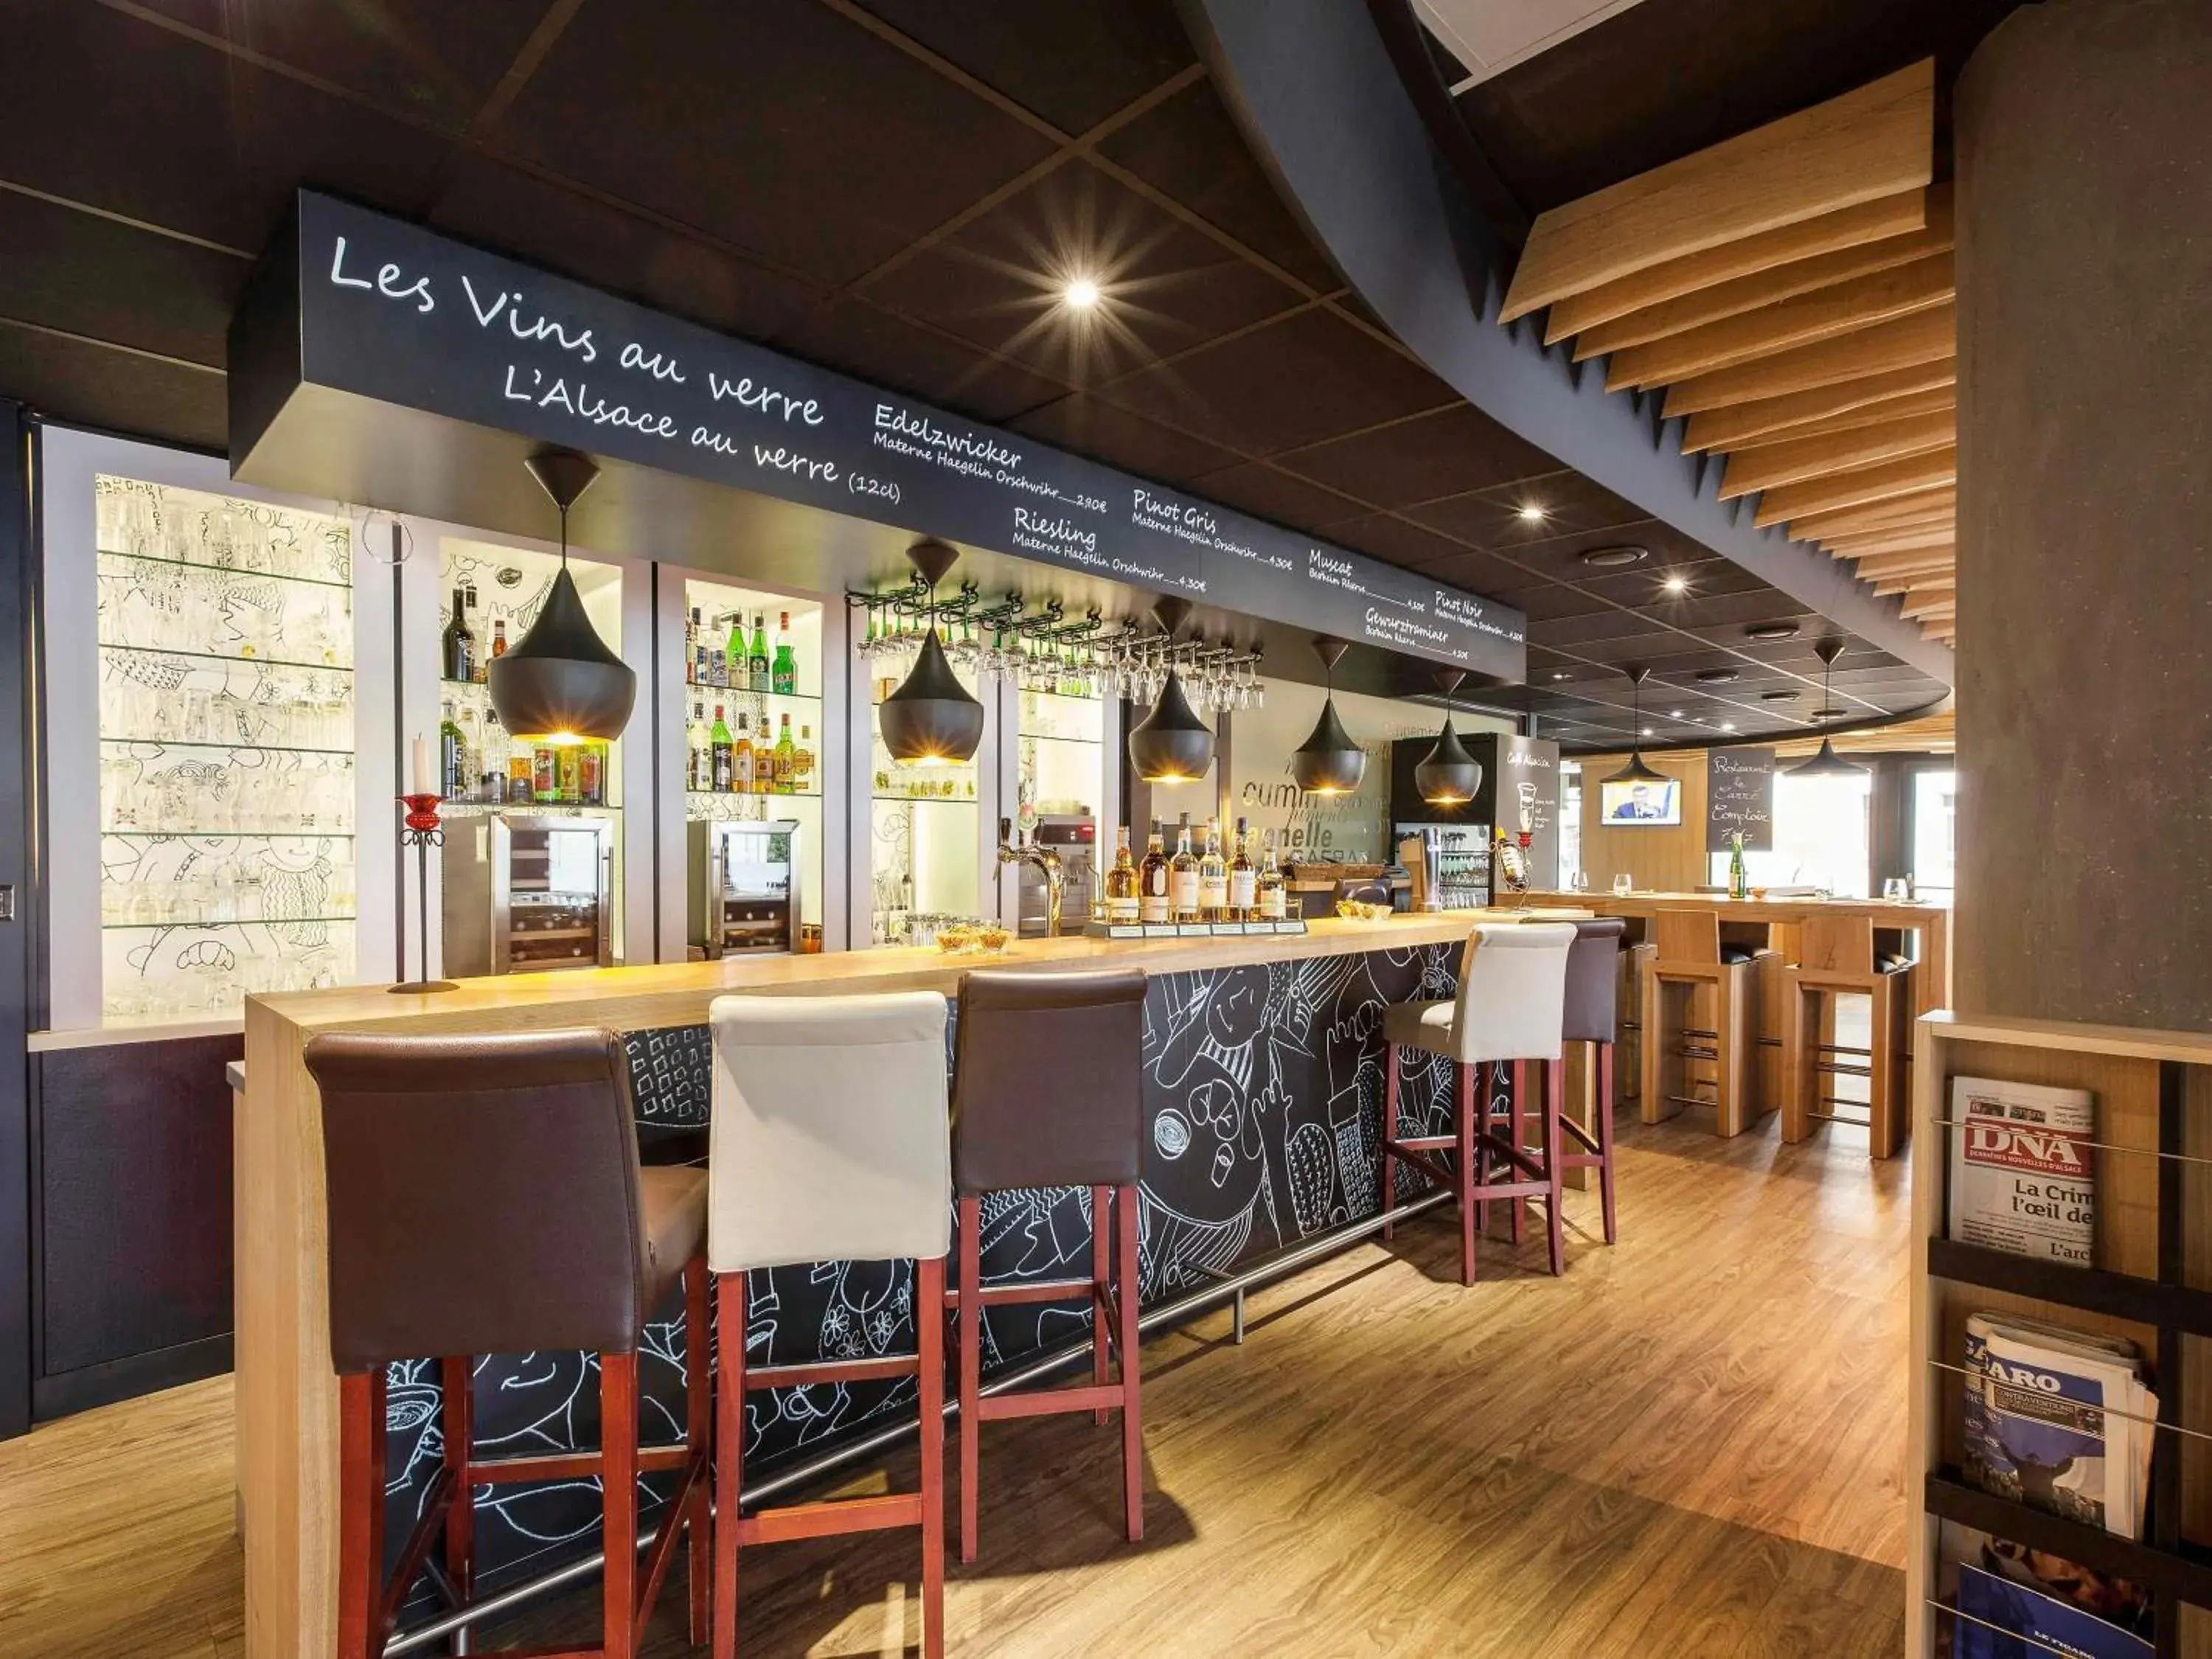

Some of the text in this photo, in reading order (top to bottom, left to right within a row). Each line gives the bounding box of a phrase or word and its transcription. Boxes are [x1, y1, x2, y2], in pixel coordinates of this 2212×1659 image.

[331, 236, 824, 425] Les Vins au verre
[504, 364, 901, 505] L'Alsace au verre (12cl)
[875, 403, 1022, 468] Edelzwicker
[874, 431, 933, 461] Materne
[937, 451, 993, 479] Haegelin
[996, 470, 1060, 498] Orschwihr
[1014, 507, 1096, 552] Riesling
[1132, 512, 1172, 533] Materne
[1174, 525, 1211, 546] Haegelin
[1133, 489, 1216, 535] Pinot Gris
[1012, 532, 1061, 554] Materne
[1064, 545, 1109, 567] Haegelin
[1113, 558, 1164, 582] Orschwihr
[1309, 549, 1352, 577] Muscat
[1436, 591, 1461, 612] Pinot
[1970, 1122, 2081, 1166] DNA
[2016, 1179, 2039, 1197] La
[2013, 1196, 2093, 1225] l'œil de
[1985, 1357, 2062, 1393] ARO
